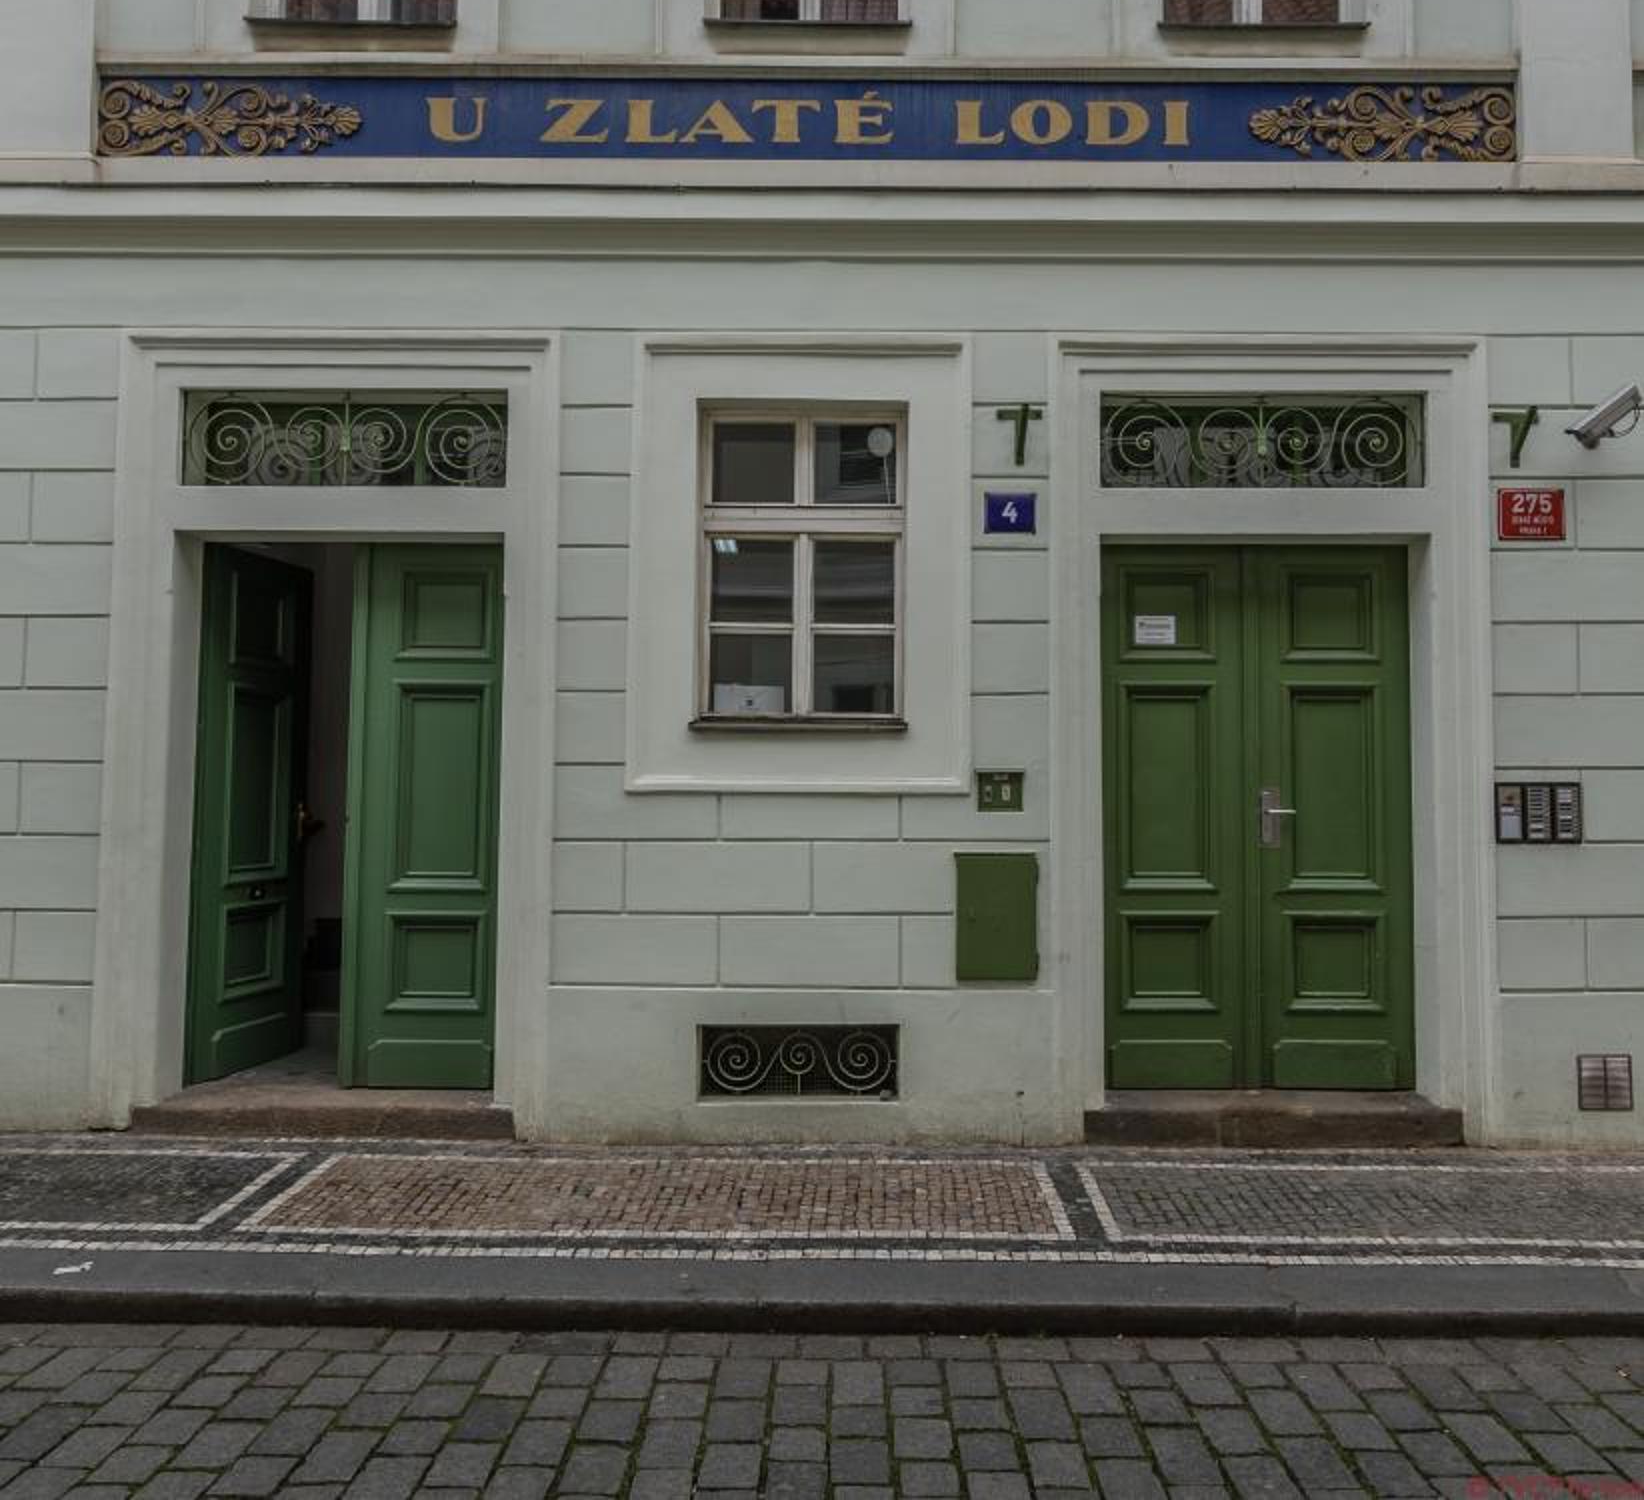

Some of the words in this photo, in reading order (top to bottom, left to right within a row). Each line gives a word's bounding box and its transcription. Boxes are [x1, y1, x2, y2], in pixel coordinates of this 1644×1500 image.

[425, 97, 488, 142] U
[540, 91, 894, 145] ZLATÉ
[954, 100, 1190, 145] LODI
[1002, 502, 1018, 523] 4
[1512, 494, 1552, 514] 275
